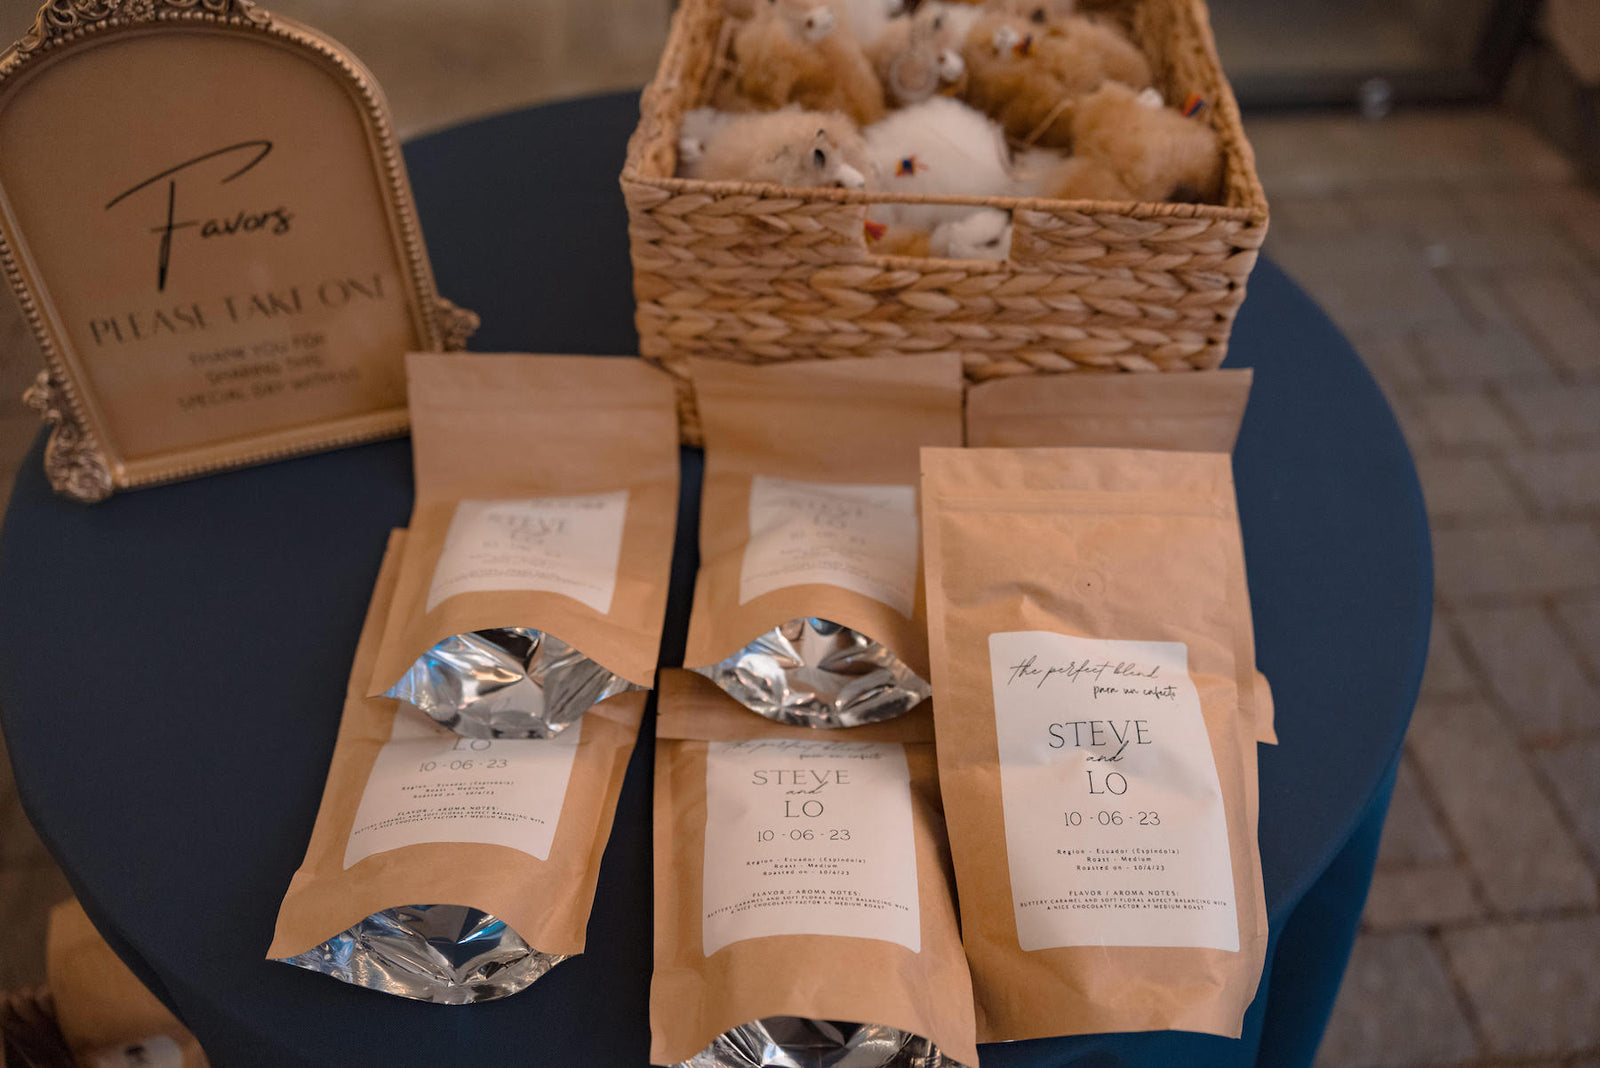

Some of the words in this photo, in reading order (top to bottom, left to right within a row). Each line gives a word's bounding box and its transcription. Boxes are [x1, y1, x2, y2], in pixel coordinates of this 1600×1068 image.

[106, 140, 294, 293] Favors
[90, 304, 206, 347] PLEASE
[225, 287, 303, 323] TAKE
[317, 273, 384, 305] ONE
[1008, 654, 1042, 685] the
[1037, 659, 1115, 689] perfect
[1113, 661, 1161, 679] blend
[1093, 685, 1118, 699] para
[1123, 687, 1139, 695] un
[1048, 719, 1152, 749] STEVE
[1086, 740, 1129, 762] and
[419, 761, 437, 773] 10
[450, 760, 473, 770] 06
[486, 759, 508, 769] 23
[752, 769, 851, 786] STEVE
[1086, 770, 1128, 795] LO
[785, 780, 829, 795] and
[784, 800, 824, 818] LO
[1064, 811, 1082, 826] 10
[1097, 810, 1124, 826] 06
[1137, 810, 1161, 826] 23
[757, 829, 775, 843] 10
[789, 828, 815, 841] 06
[829, 829, 851, 841] 23
[1057, 848, 1085, 856] Region
[1096, 847, 1128, 855] Ecuador
[746, 858, 773, 866] Region
[752, 889, 784, 898] FLAVOR
[1068, 889, 1102, 897] FLAVOR
[707, 905, 732, 918] BUTTERY
[734, 898, 763, 908] CARAMEL
[855, 897, 892, 907] BALANCING
[894, 903, 909, 911] WITH
[753, 900, 792, 909] CHOCOLATY
[1020, 899, 1048, 908] BUTTERY
[1050, 897, 1081, 905] CARAMEL
[1174, 897, 1211, 905] BALANCING
